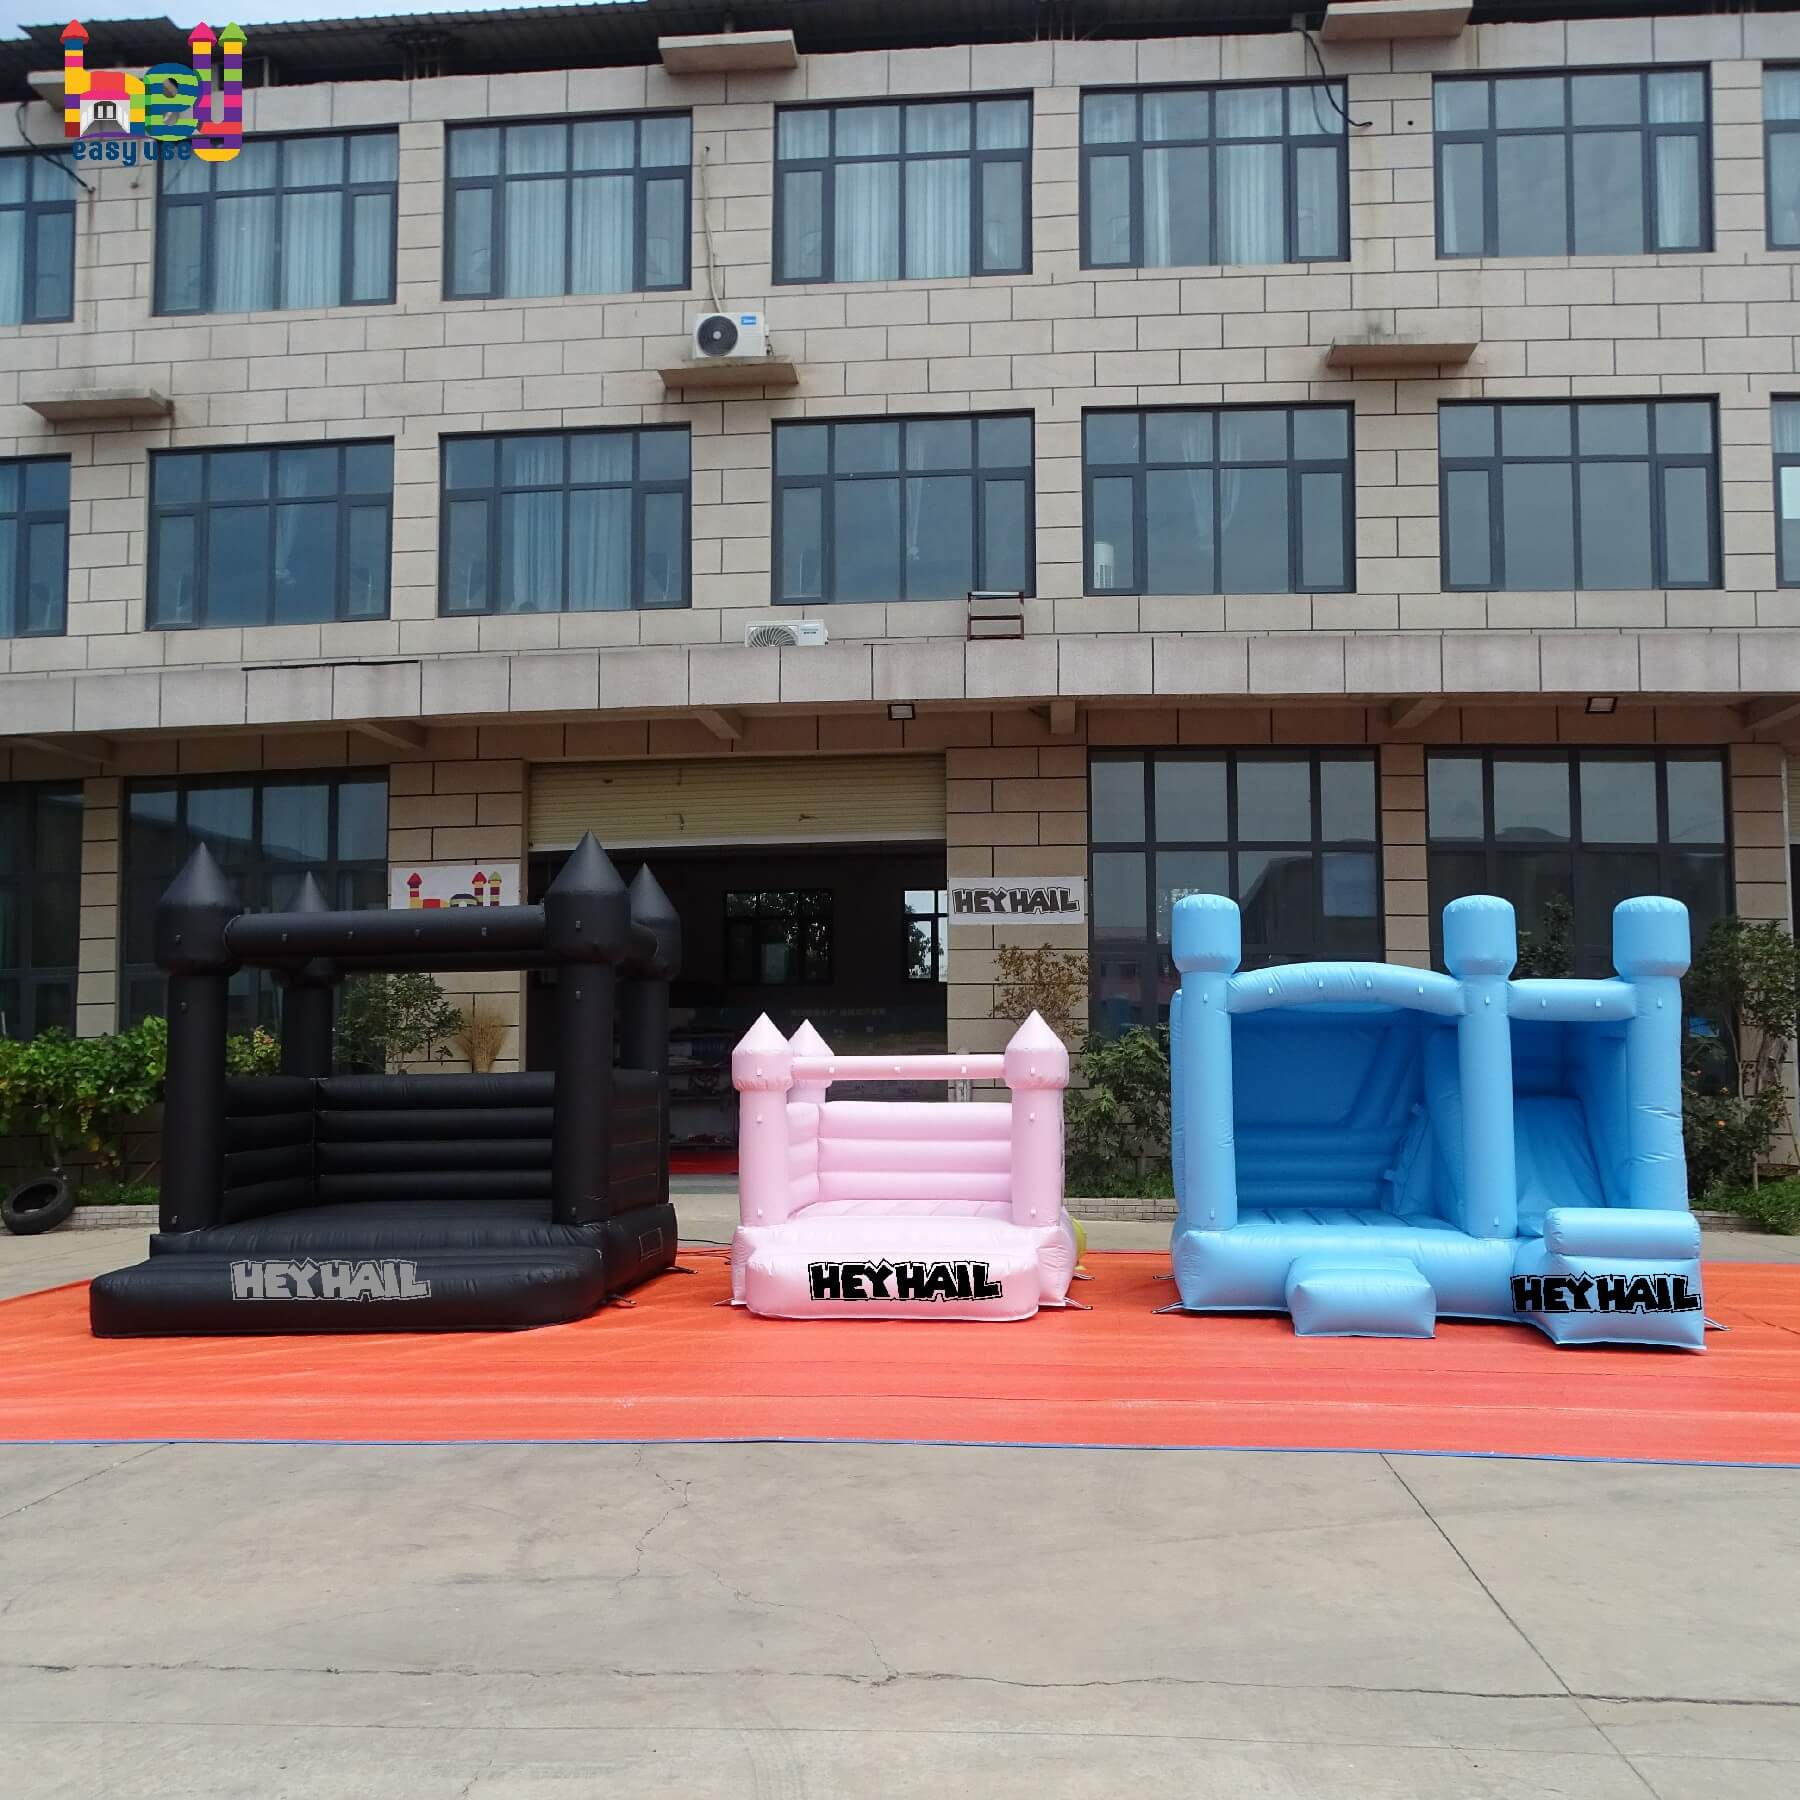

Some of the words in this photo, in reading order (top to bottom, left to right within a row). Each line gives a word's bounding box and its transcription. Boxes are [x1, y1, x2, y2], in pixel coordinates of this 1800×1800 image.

[952, 886, 1080, 914] HEYHAIL
[230, 1257, 431, 1302] HEYHAIL
[808, 1258, 1003, 1302] HEYHAIL
[1510, 1271, 1702, 1313] HEYHAIL
